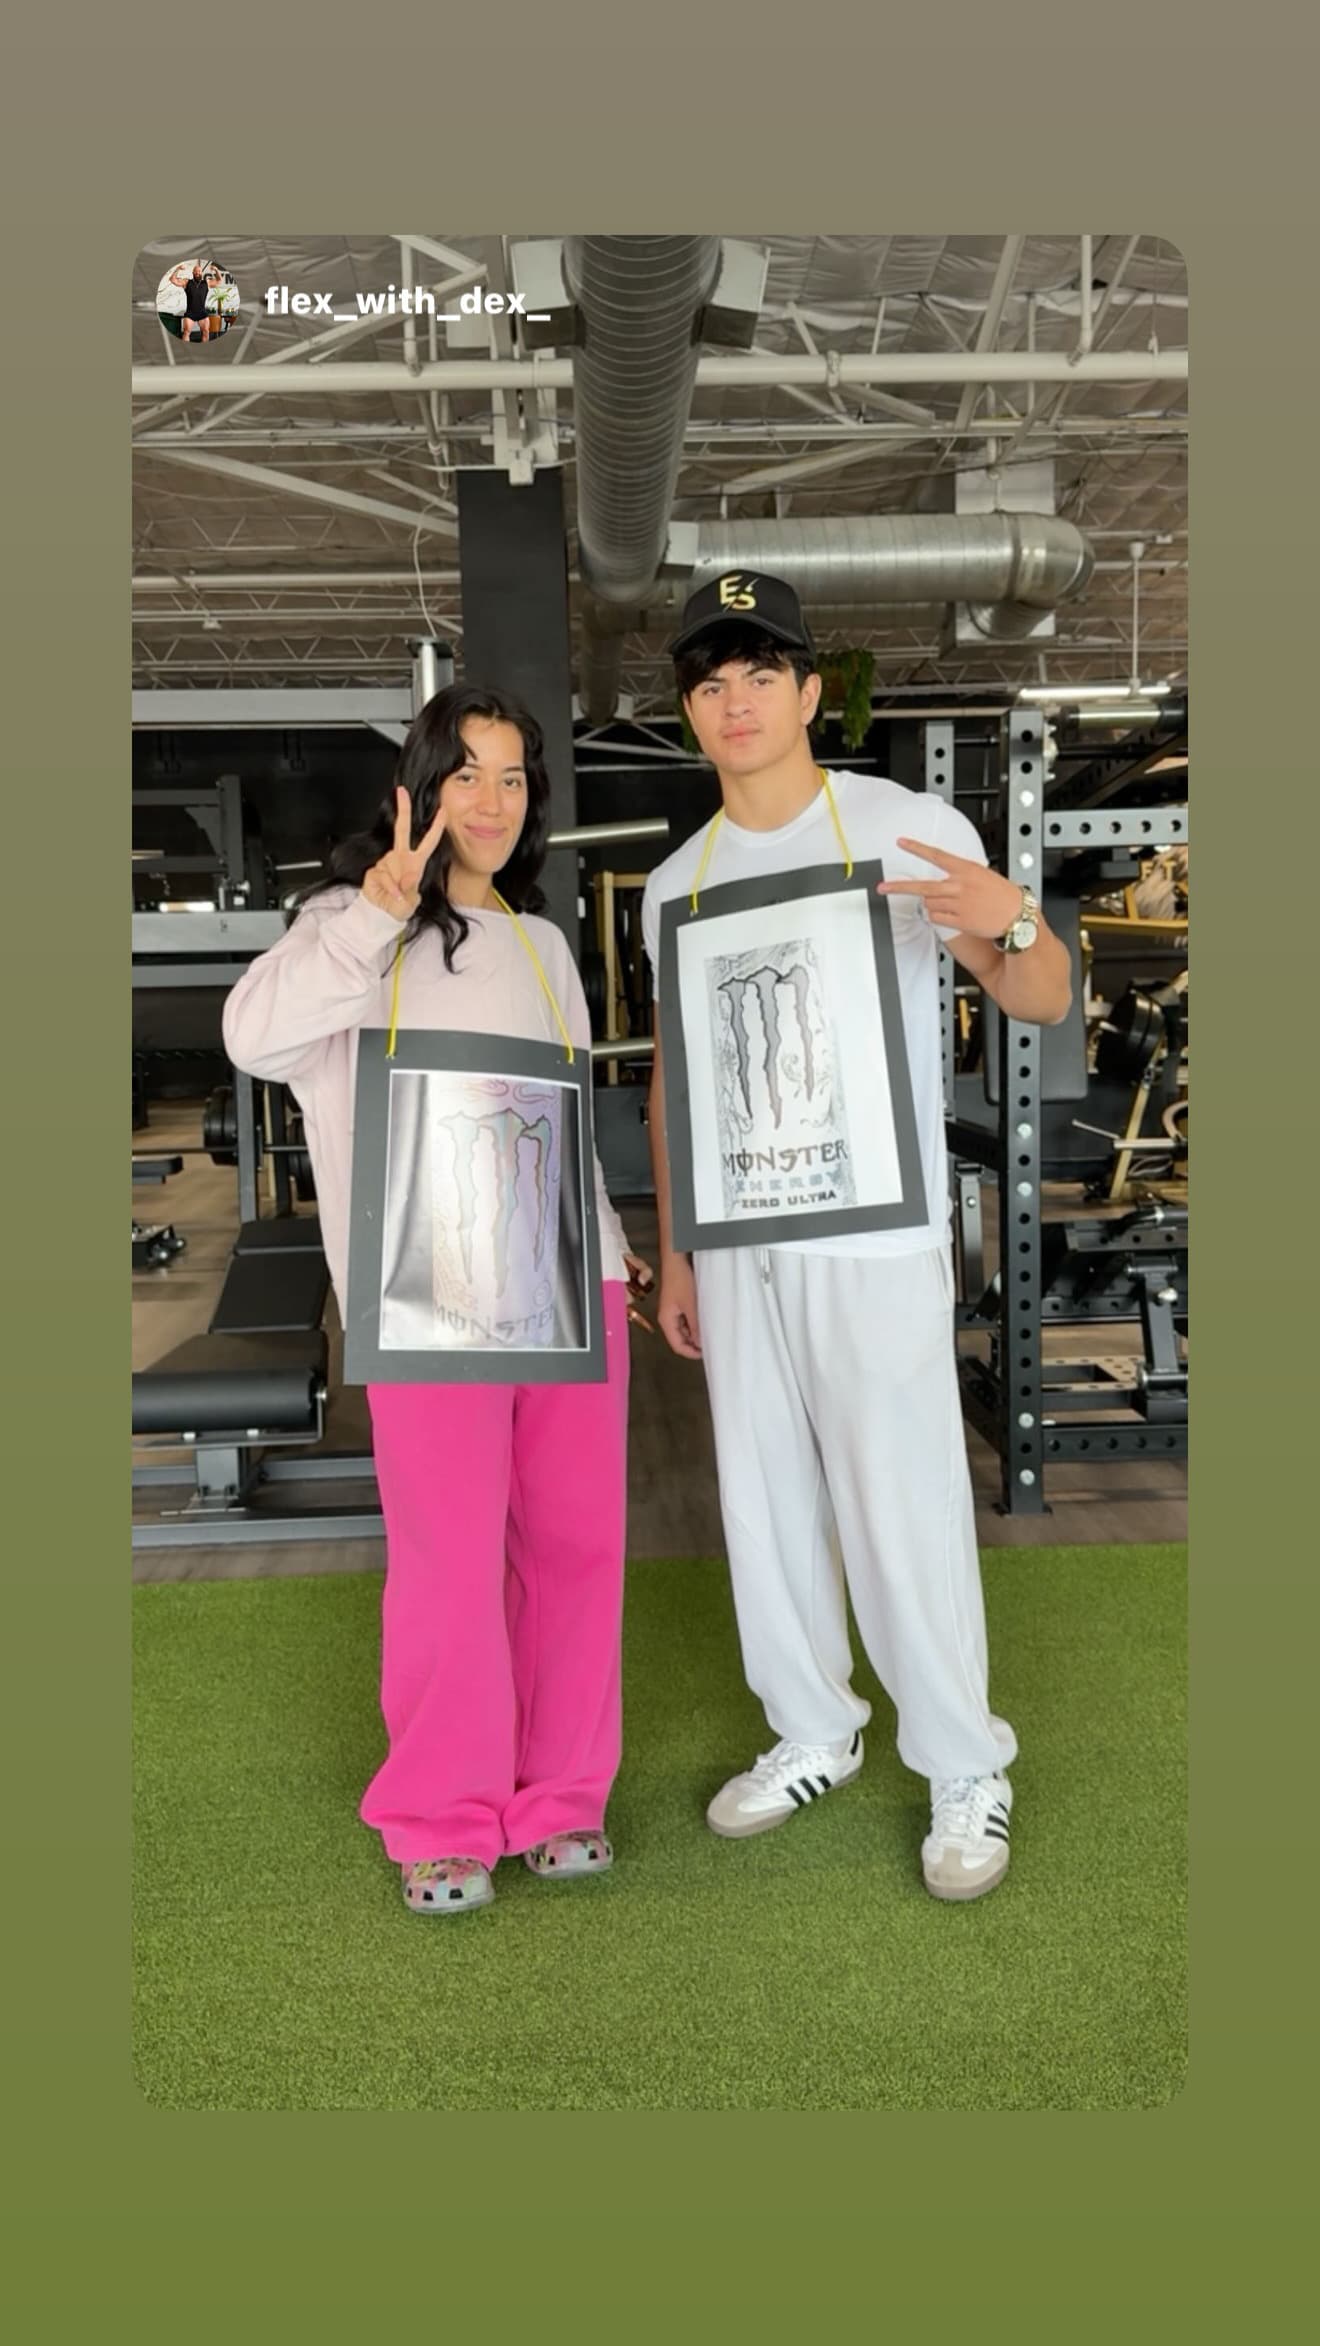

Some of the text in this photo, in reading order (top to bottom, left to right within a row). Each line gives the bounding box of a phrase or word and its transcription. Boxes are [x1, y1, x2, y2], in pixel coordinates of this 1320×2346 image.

[722, 1139, 848, 1177] MONSTER
[741, 1190, 837, 1209] ZERO ULTRA
